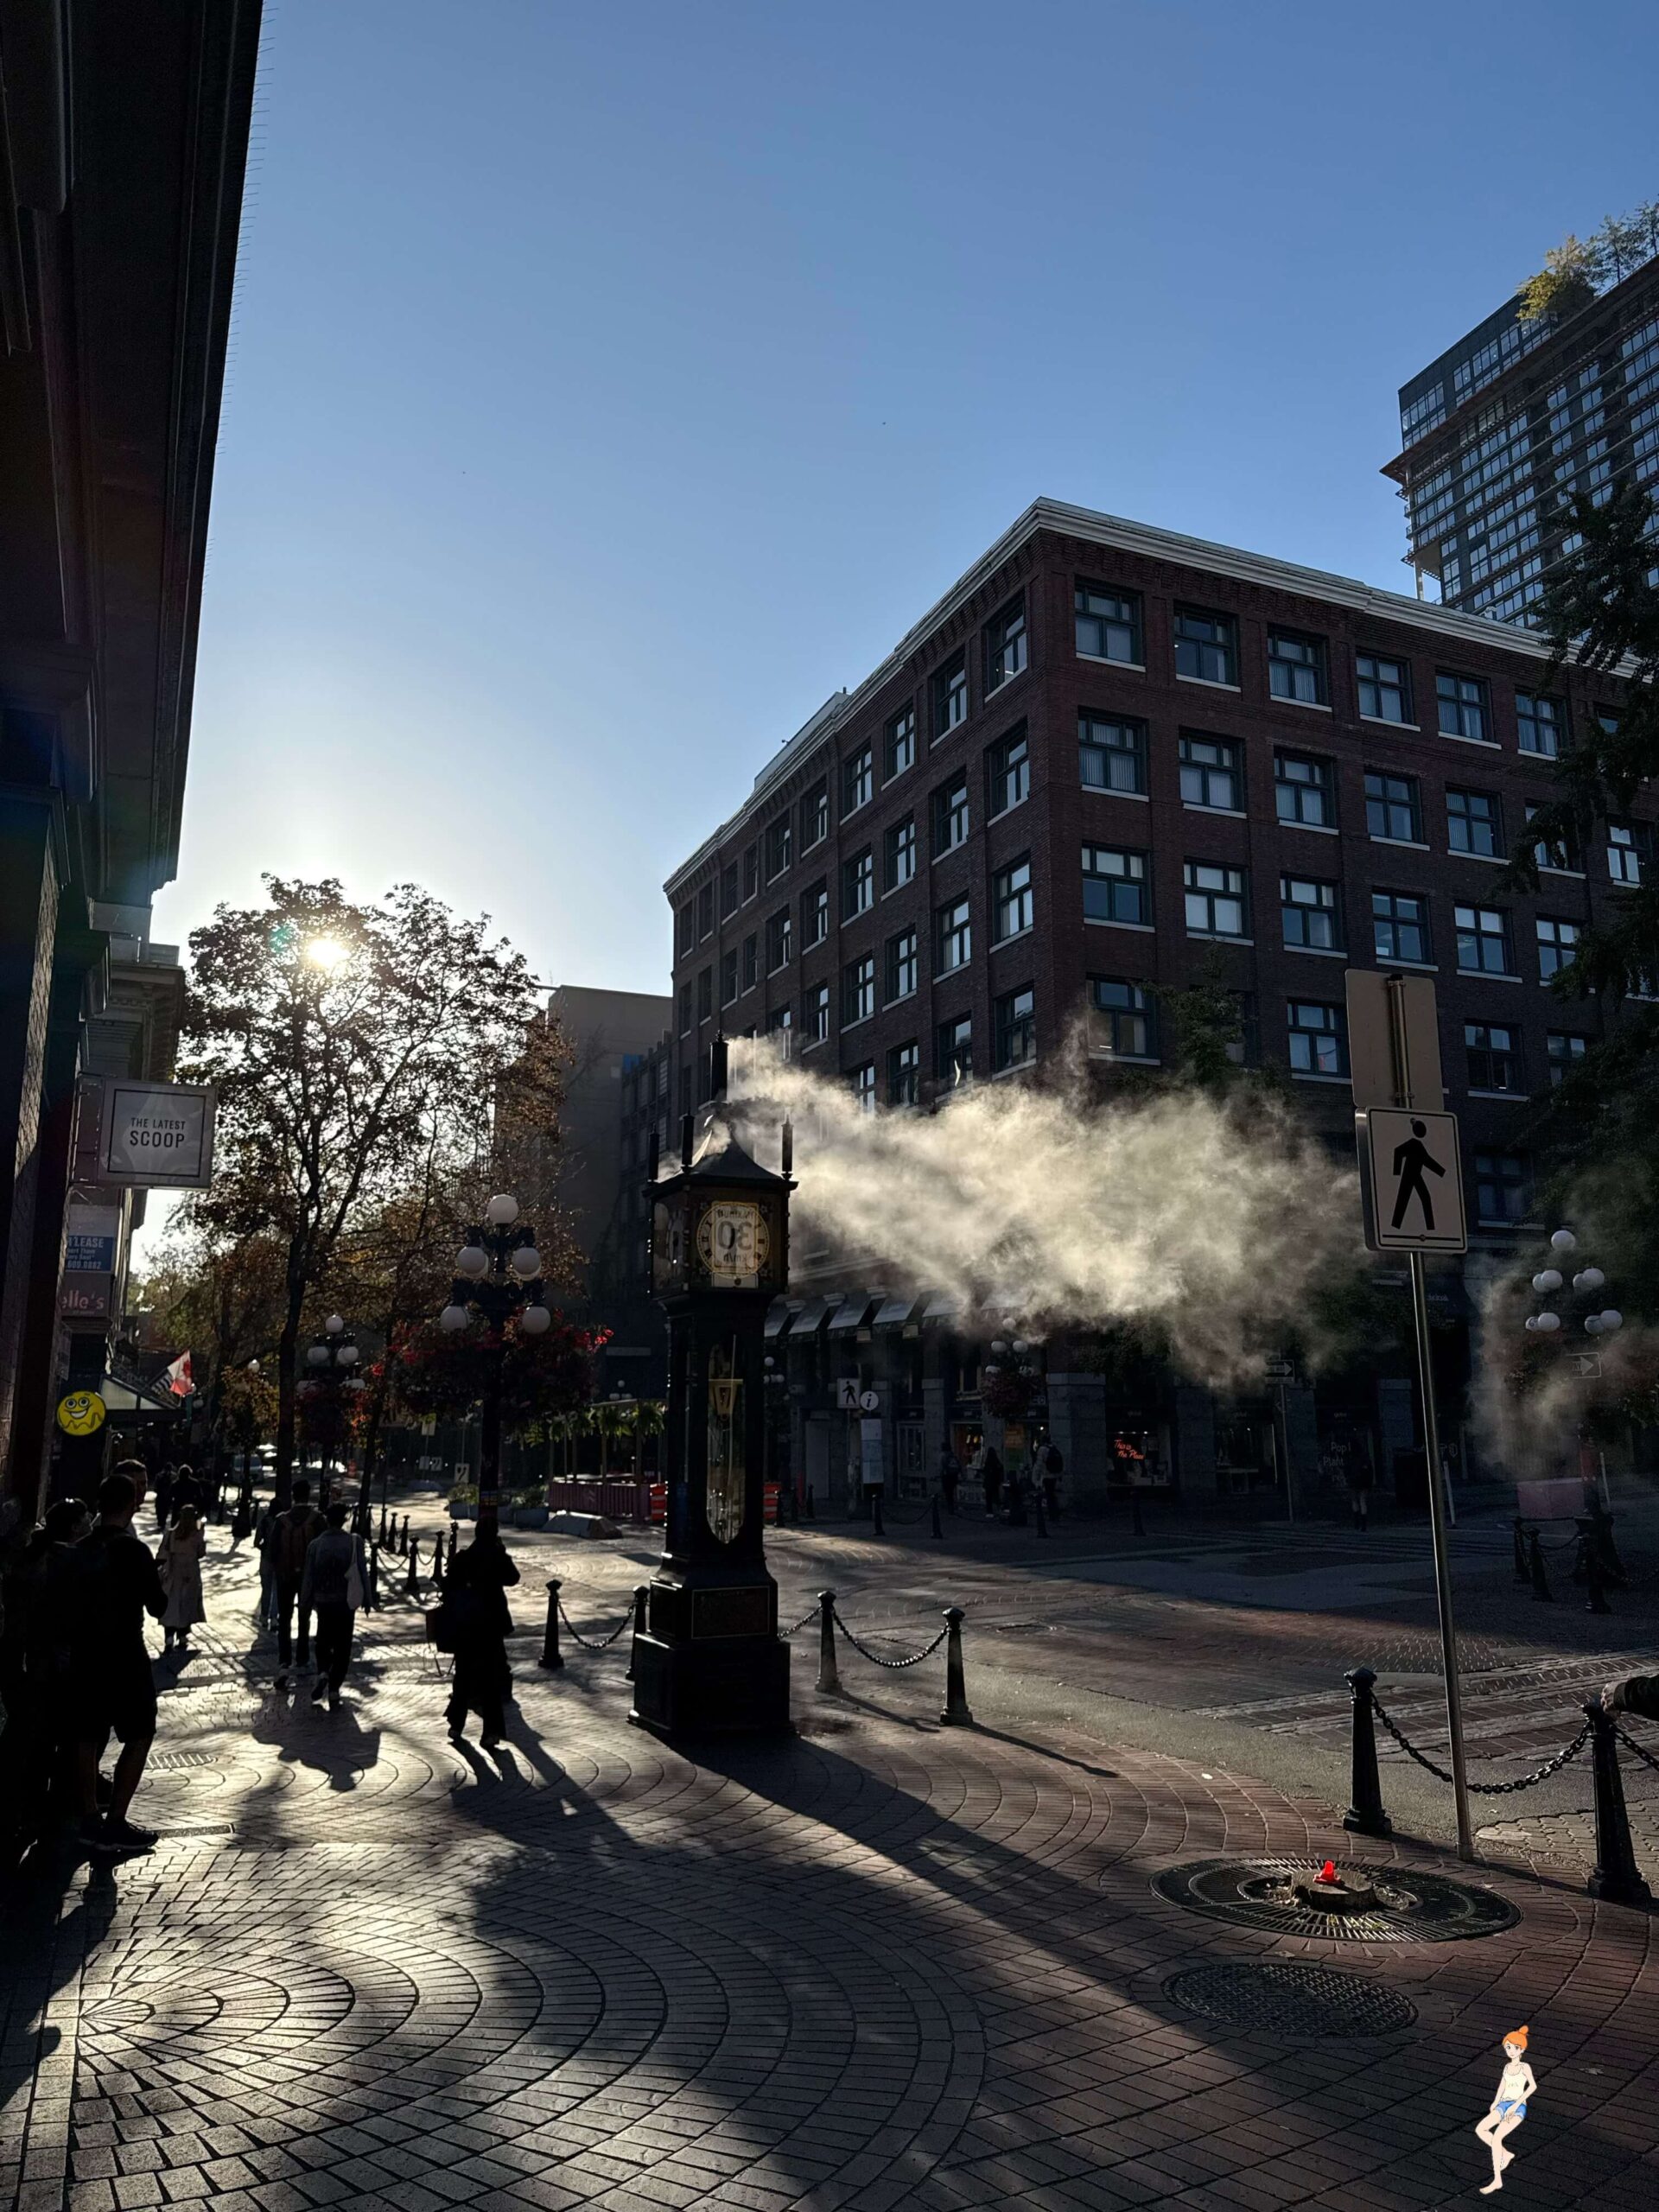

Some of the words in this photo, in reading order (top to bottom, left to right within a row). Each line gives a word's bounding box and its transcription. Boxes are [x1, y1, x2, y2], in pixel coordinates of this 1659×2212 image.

[131, 1118, 148, 1128] THE
[153, 1119, 186, 1130] LATEST
[130, 1130, 185, 1148] SCOOP
